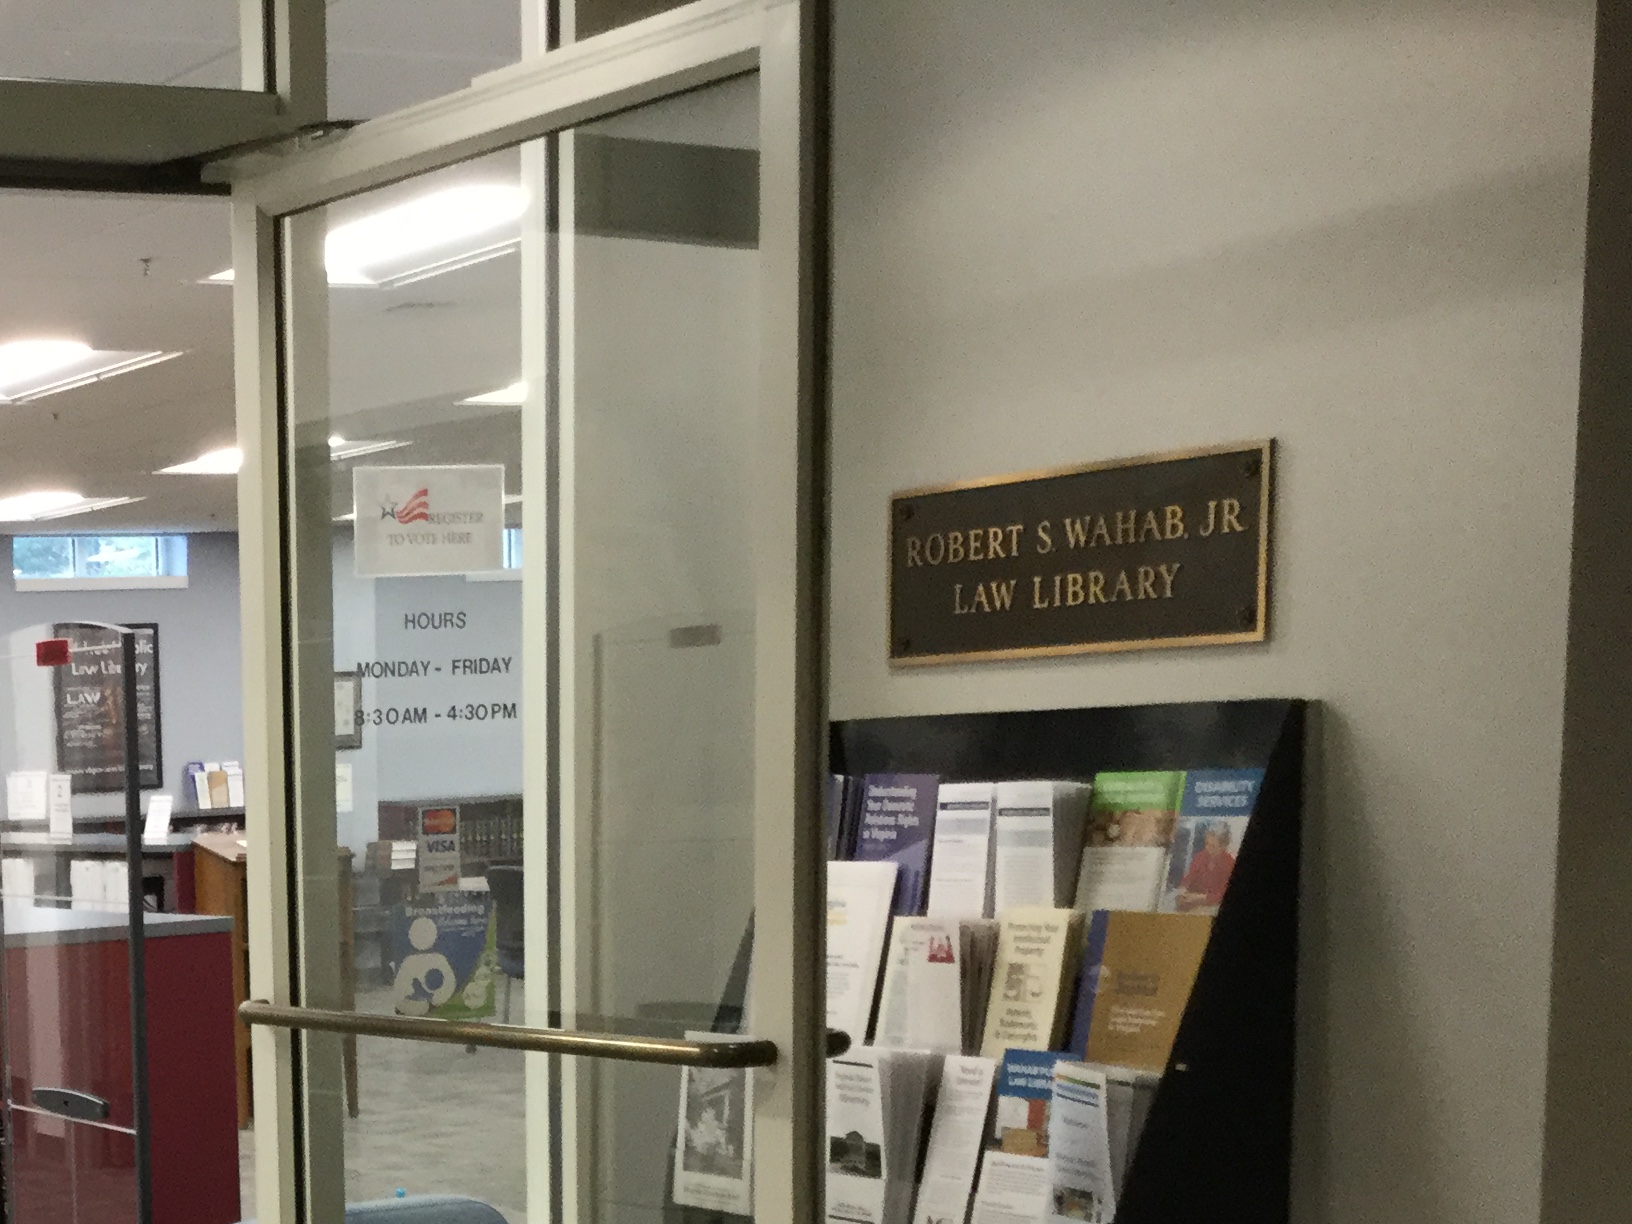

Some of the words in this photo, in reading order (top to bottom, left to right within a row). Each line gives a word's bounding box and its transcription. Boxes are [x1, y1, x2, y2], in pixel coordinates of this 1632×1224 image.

[428, 511, 484, 525] REGISTER
[387, 532, 405, 546] TO
[408, 532, 438, 546] VOTE
[440, 531, 472, 545] HERE
[906, 523, 1024, 568] ROBERT
[953, 580, 1017, 614] LAW
[1031, 562, 1183, 611] LIBRARY
[404, 611, 467, 630] HOURS
[356, 660, 431, 679] MONDAY
[451, 656, 513, 676] FRIDAY
[66, 692, 101, 705] LAW
[425, 839, 456, 854] VISA
